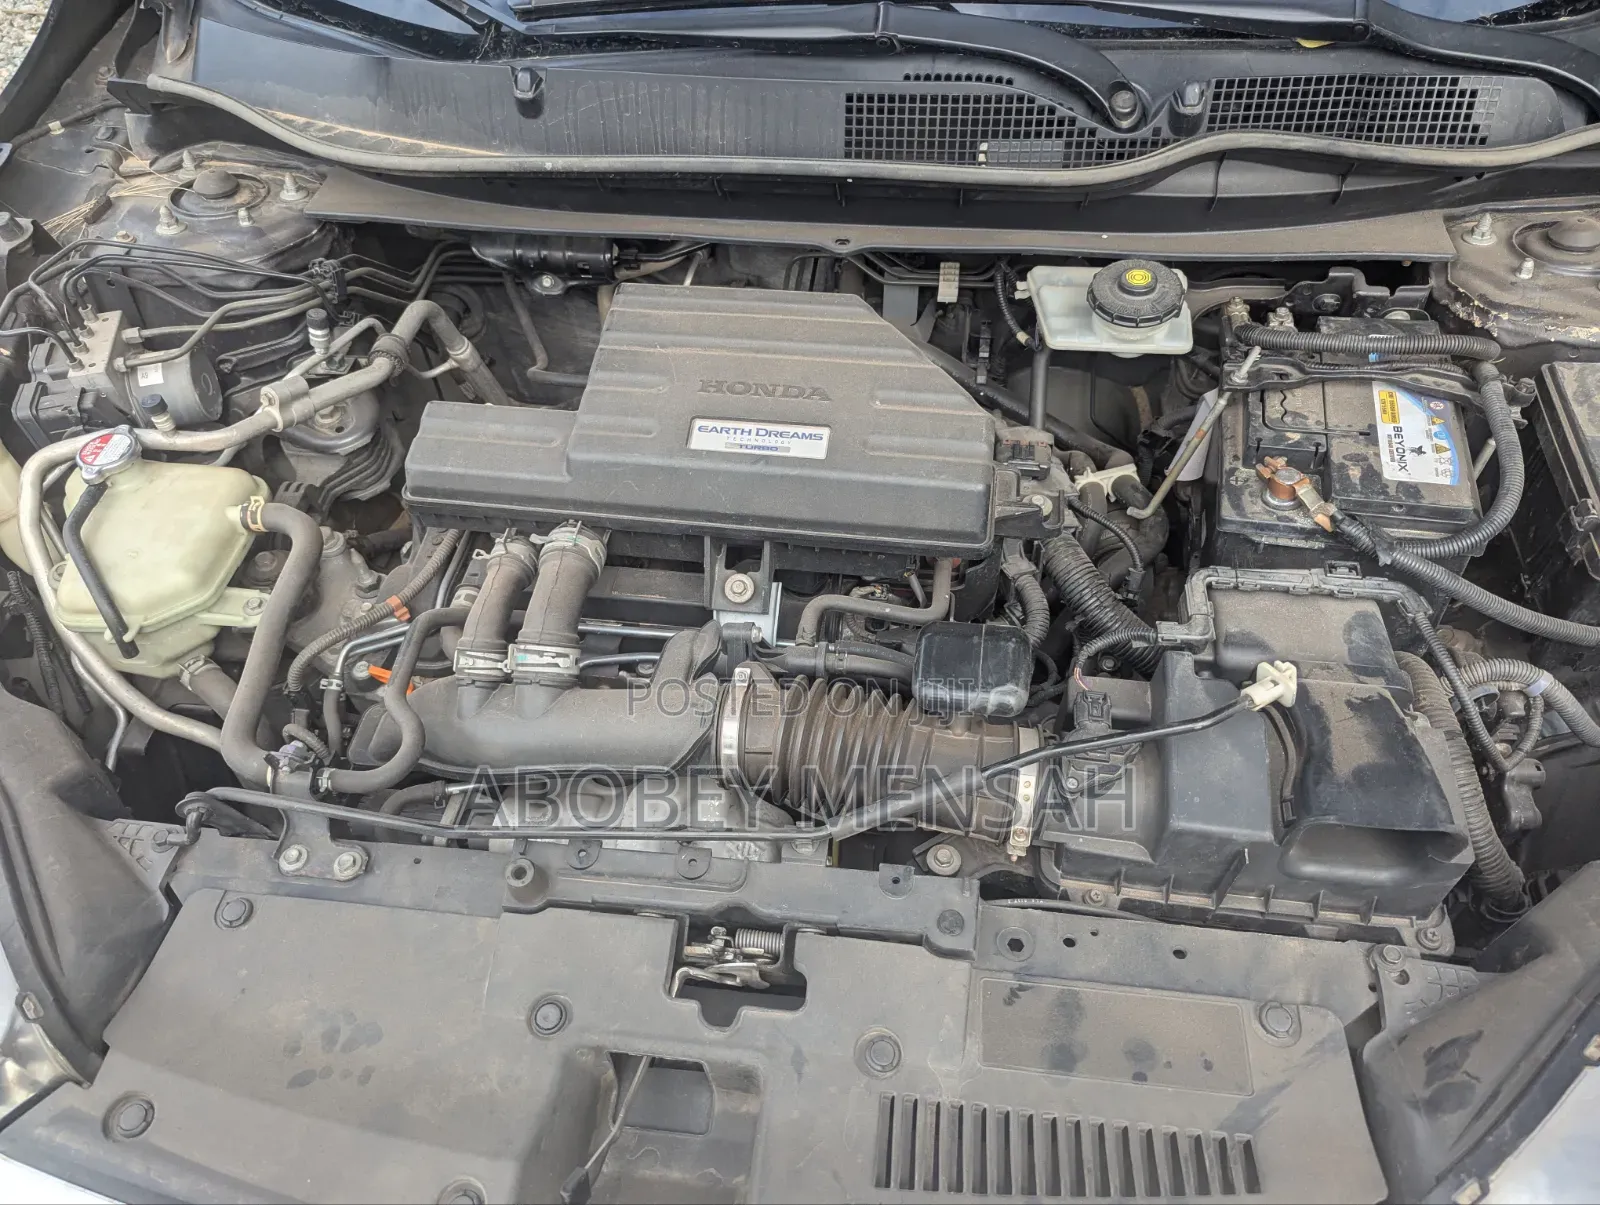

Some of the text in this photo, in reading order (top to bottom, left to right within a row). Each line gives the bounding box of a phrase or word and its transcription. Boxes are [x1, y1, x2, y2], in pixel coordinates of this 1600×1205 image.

[697, 380, 832, 401] HONDA
[697, 425, 824, 441] EARTH DREAMS
[739, 444, 779, 452] TURBO
[1393, 425, 1409, 473] BEYONIX
